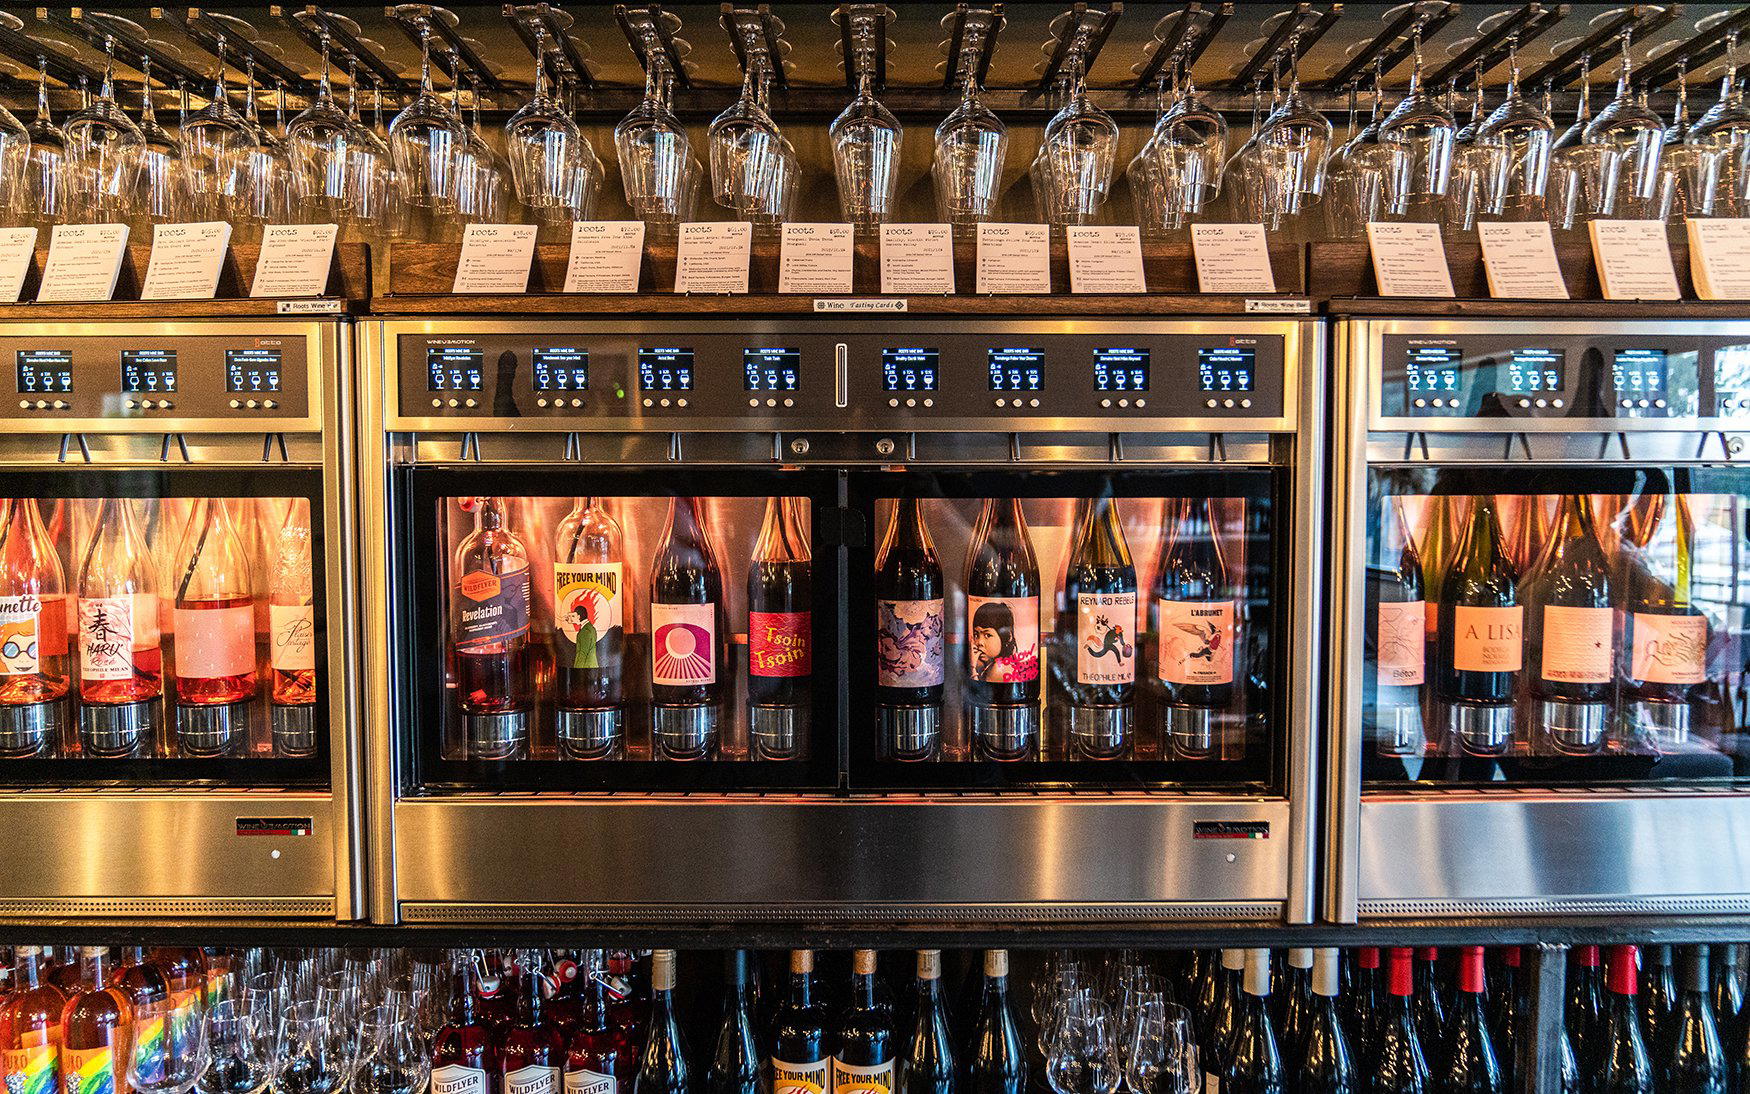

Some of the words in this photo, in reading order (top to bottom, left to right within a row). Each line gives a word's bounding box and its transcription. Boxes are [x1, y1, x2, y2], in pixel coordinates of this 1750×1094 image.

[787, 227, 815, 235] roots
[885, 228, 912, 236] roots
[849, 301, 874, 309] Tasting
[556, 571, 570, 594] FREE
[571, 572, 594, 583] YOUR
[595, 571, 617, 595] MIND
[1080, 596, 1113, 606] REYNARD
[462, 604, 504, 622] Revelation
[88, 608, 117, 642] 春
[1465, 624, 1480, 640] A
[765, 625, 806, 648] Tsoin
[86, 642, 122, 659] HARU
[753, 647, 805, 669] Tsoin
[994, 643, 1036, 668] FOLLOW
[433, 1075, 479, 1093] WILDFLYER
[509, 1074, 556, 1094] WILDFLYER
[782, 1069, 804, 1081] YOUR
[805, 1067, 826, 1090] MIND
[835, 1067, 850, 1088] FREE
[851, 1073, 872, 1084] YOUR
[873, 1069, 892, 1090] MIND
